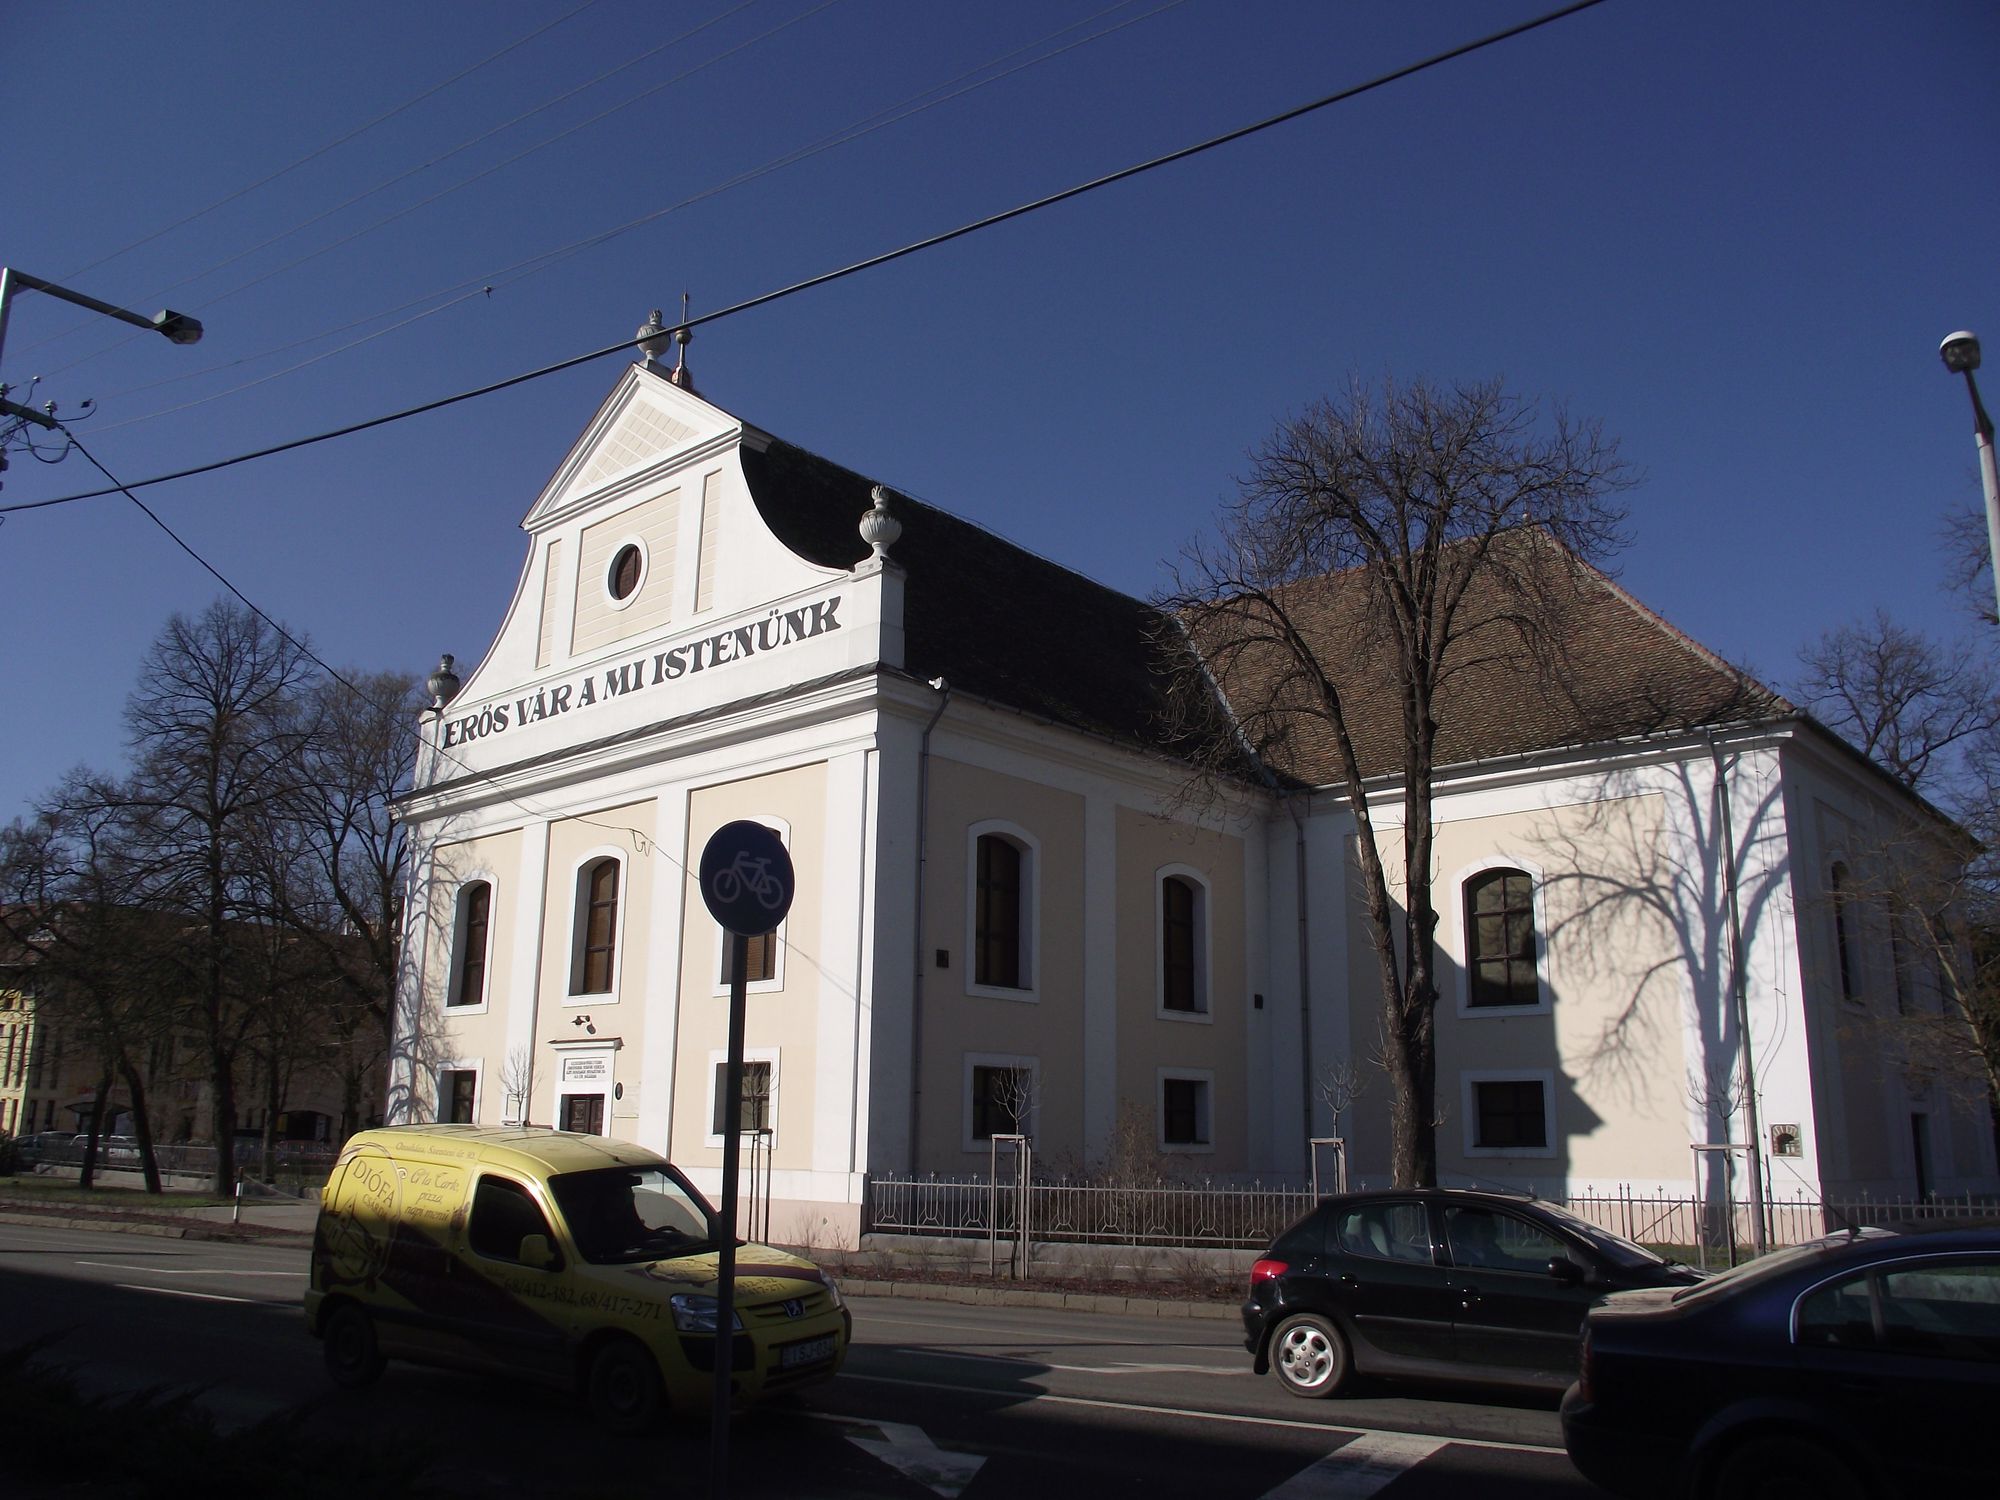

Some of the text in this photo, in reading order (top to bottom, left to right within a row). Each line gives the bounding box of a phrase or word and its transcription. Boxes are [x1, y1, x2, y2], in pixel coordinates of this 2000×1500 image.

[442, 596, 842, 750] ERŐS VÁR A MI ISTENÜNK
[353, 1160, 395, 1208] DIÓFA
[580, 1290, 662, 1320] 68/417-271
